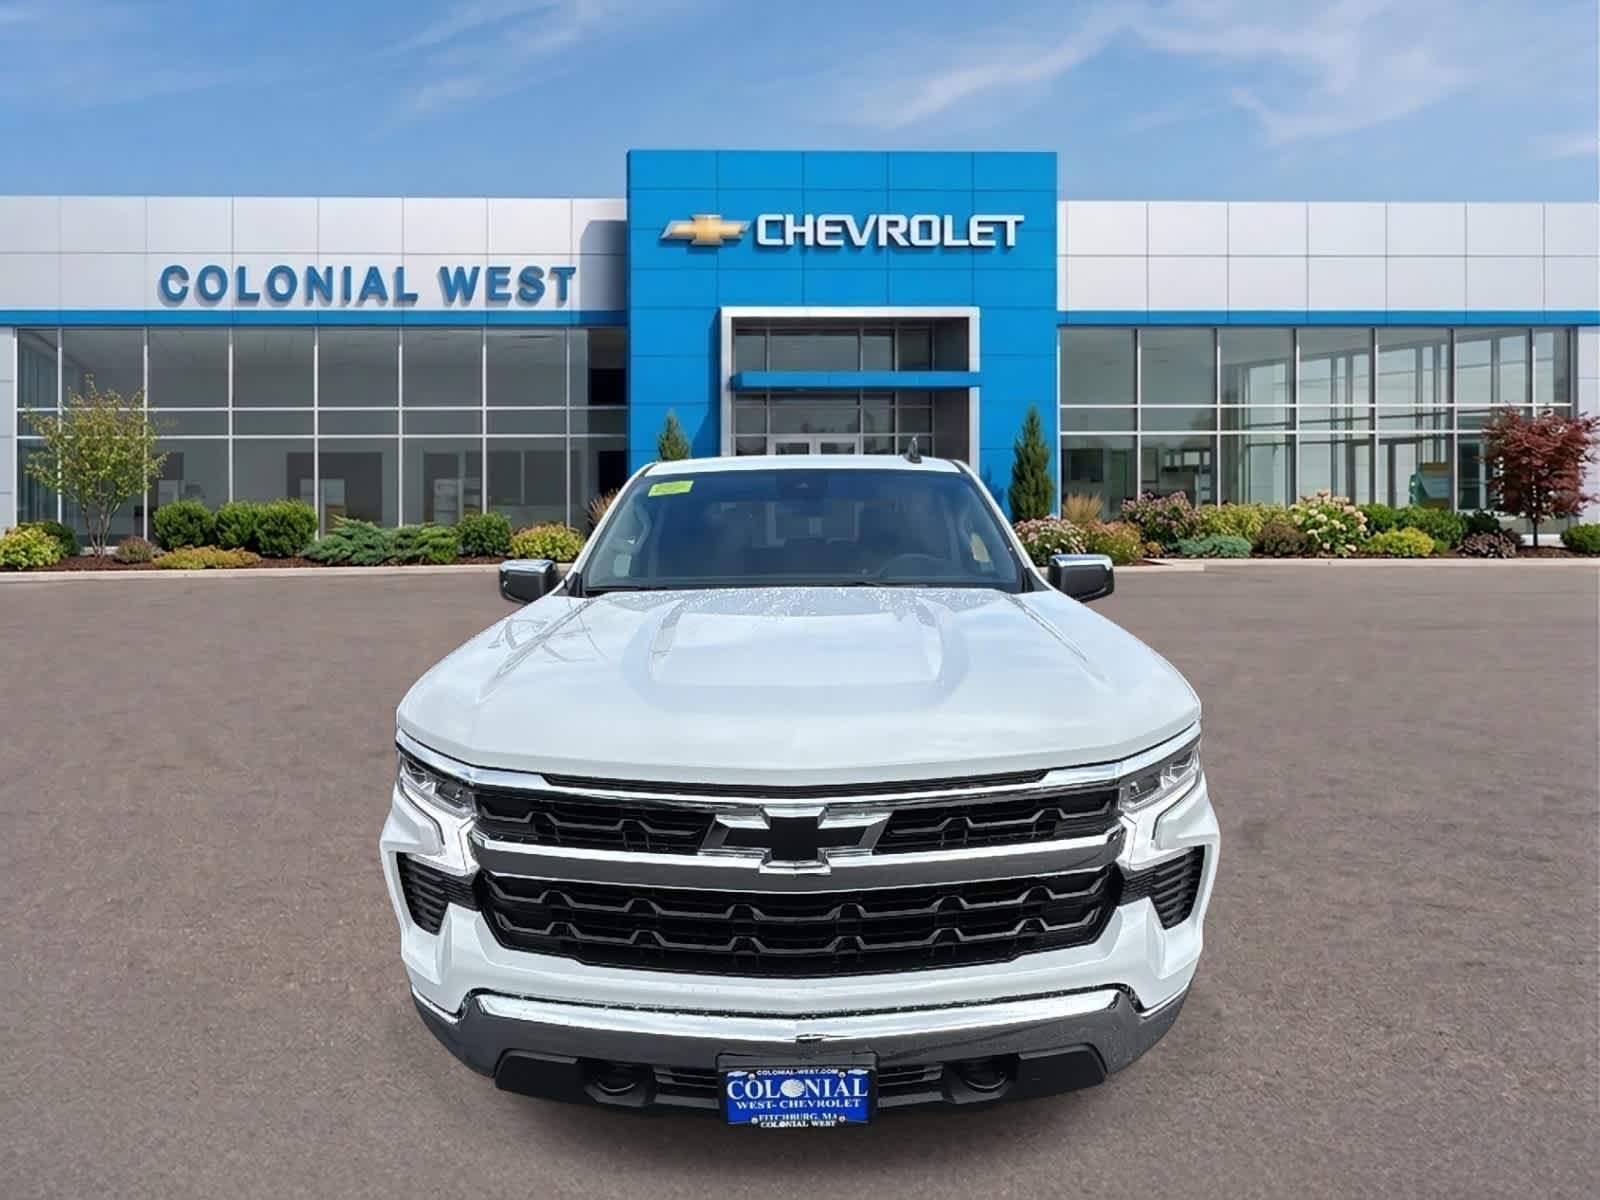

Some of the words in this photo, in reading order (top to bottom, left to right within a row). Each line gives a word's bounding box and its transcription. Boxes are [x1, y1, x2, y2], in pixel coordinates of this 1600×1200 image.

[757, 214, 1024, 247] CHEVROLET
[160, 265, 418, 303] COLONIAL
[438, 266, 577, 302] WEST
[727, 1079, 868, 1100] COLONIAL
[779, 1099, 861, 1109] CHEVROLET
[760, 1120, 809, 1128] COLONIAL
